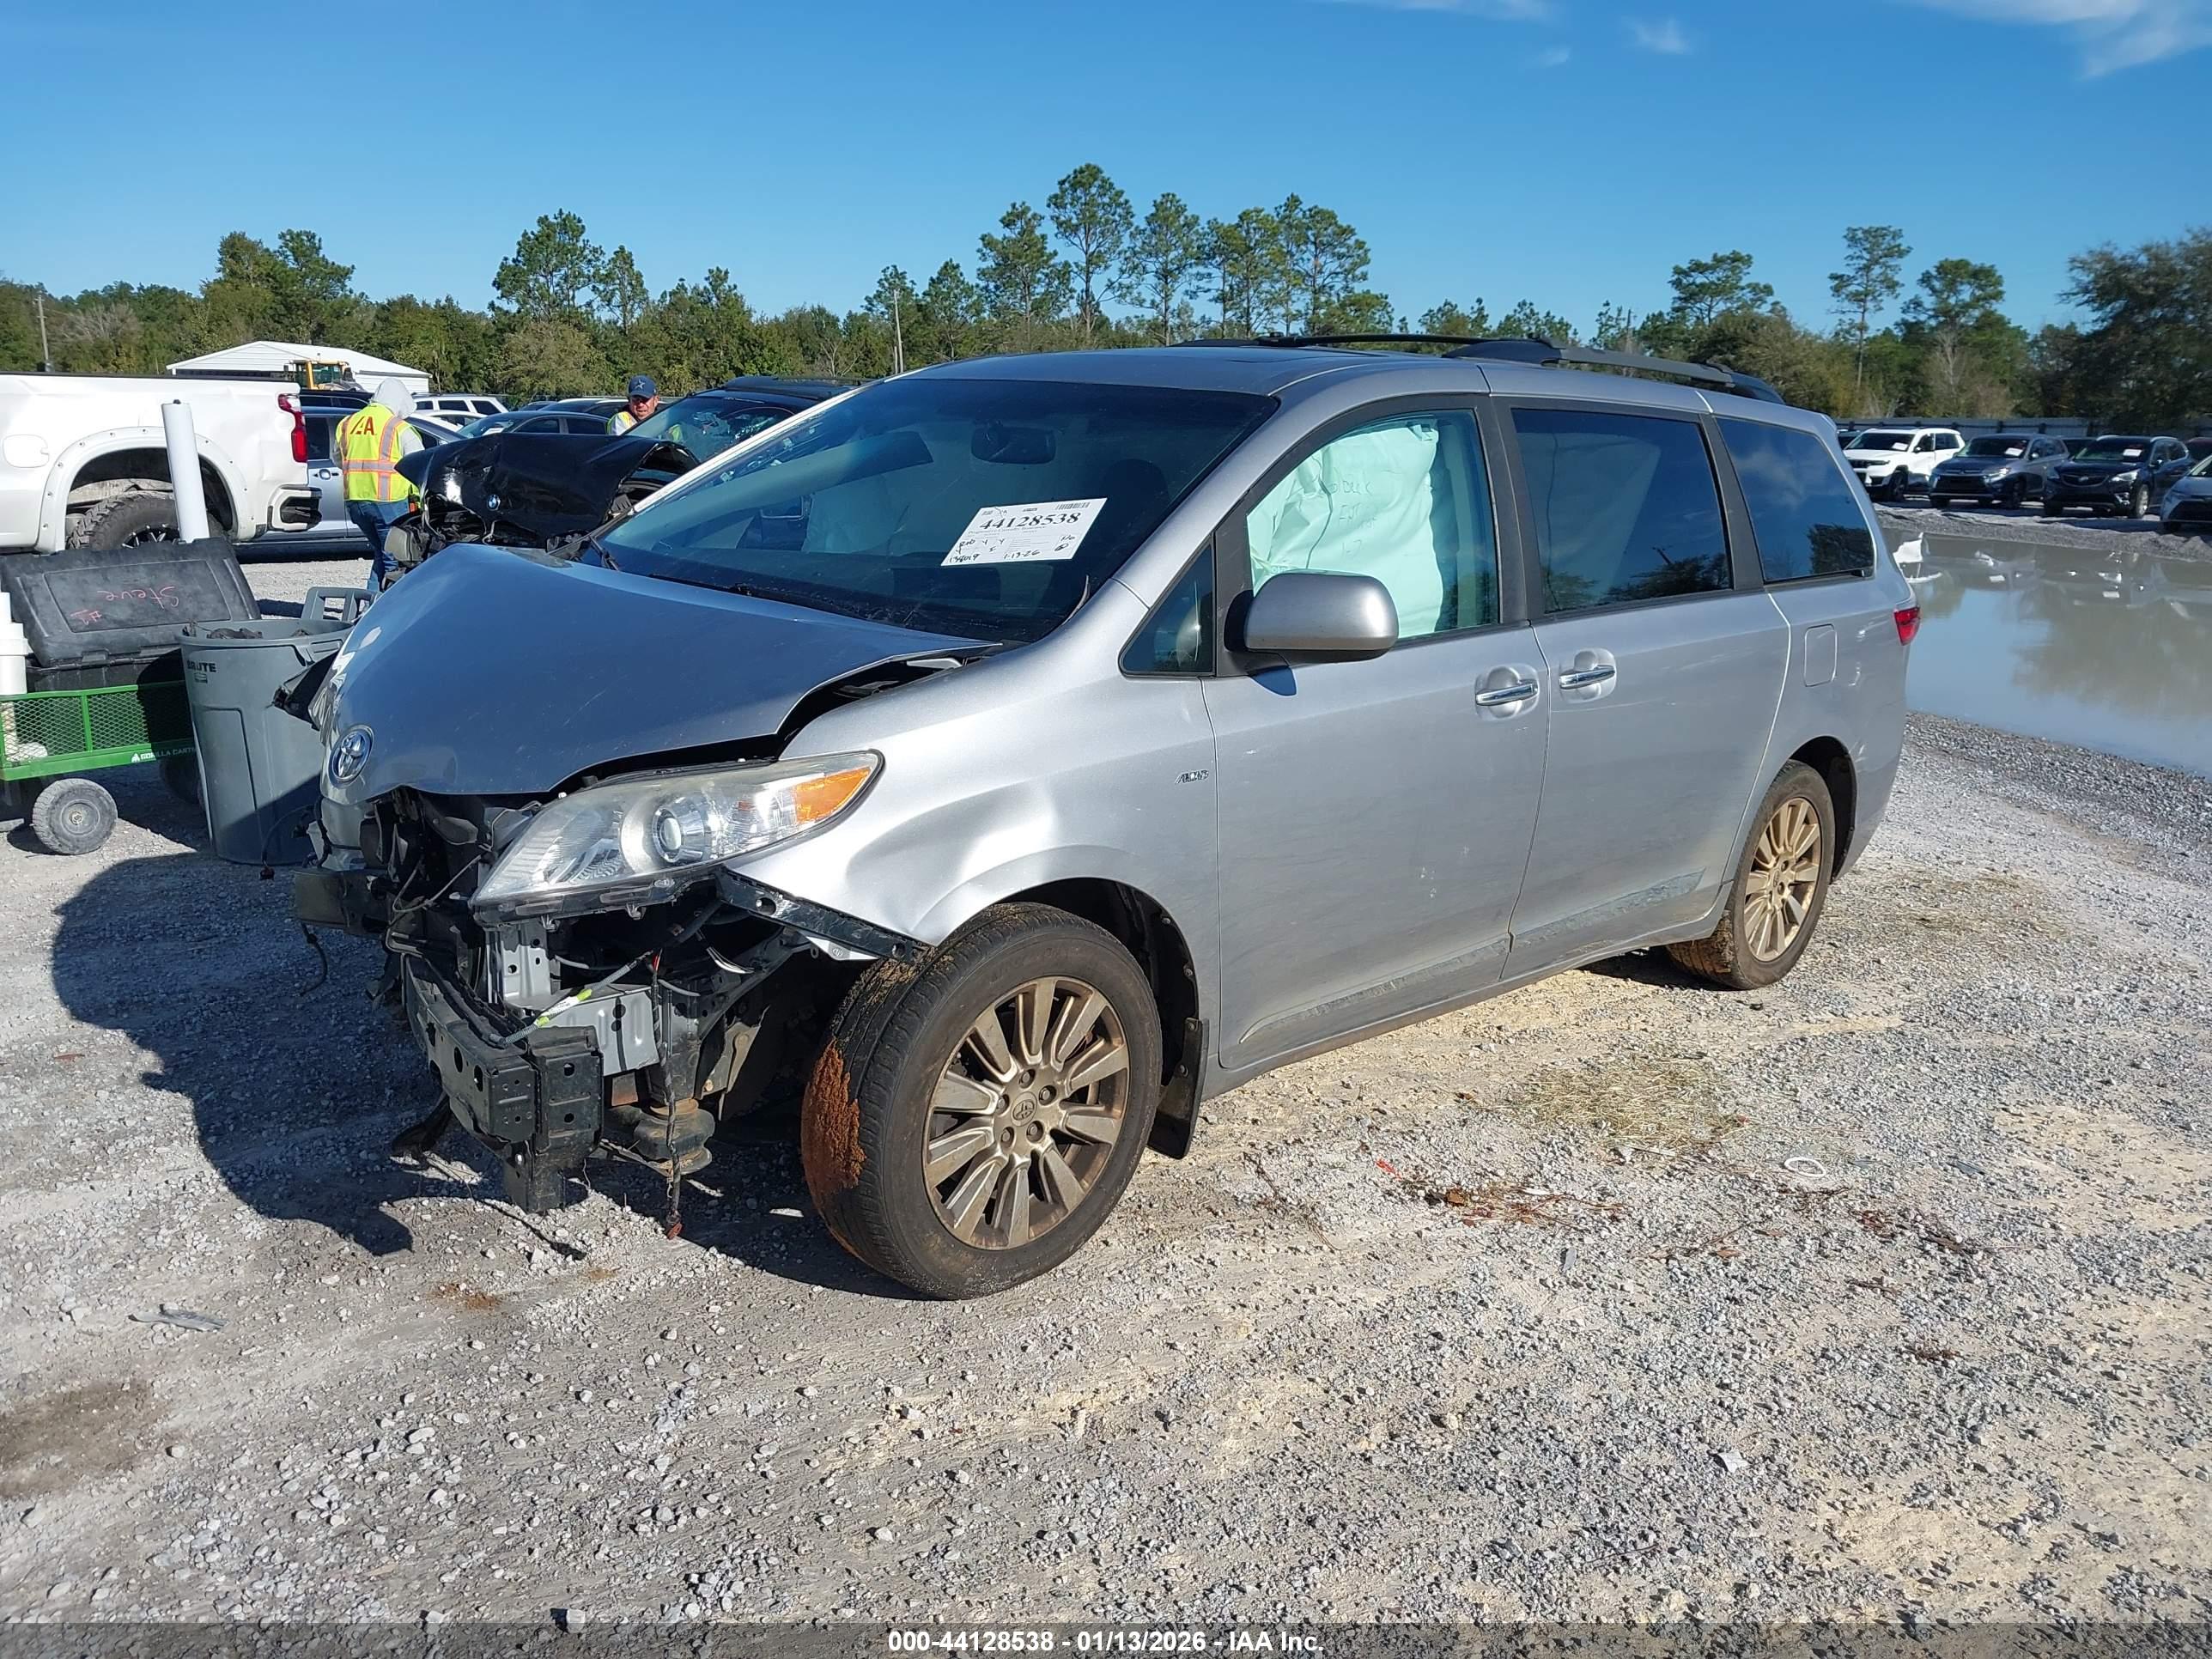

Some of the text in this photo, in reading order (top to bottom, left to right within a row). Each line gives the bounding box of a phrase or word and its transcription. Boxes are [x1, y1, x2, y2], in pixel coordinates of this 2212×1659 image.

[980, 513, 1081, 529] 44128538
[97, 586, 179, 609] Steve
[186, 660, 216, 673] BRUTE
